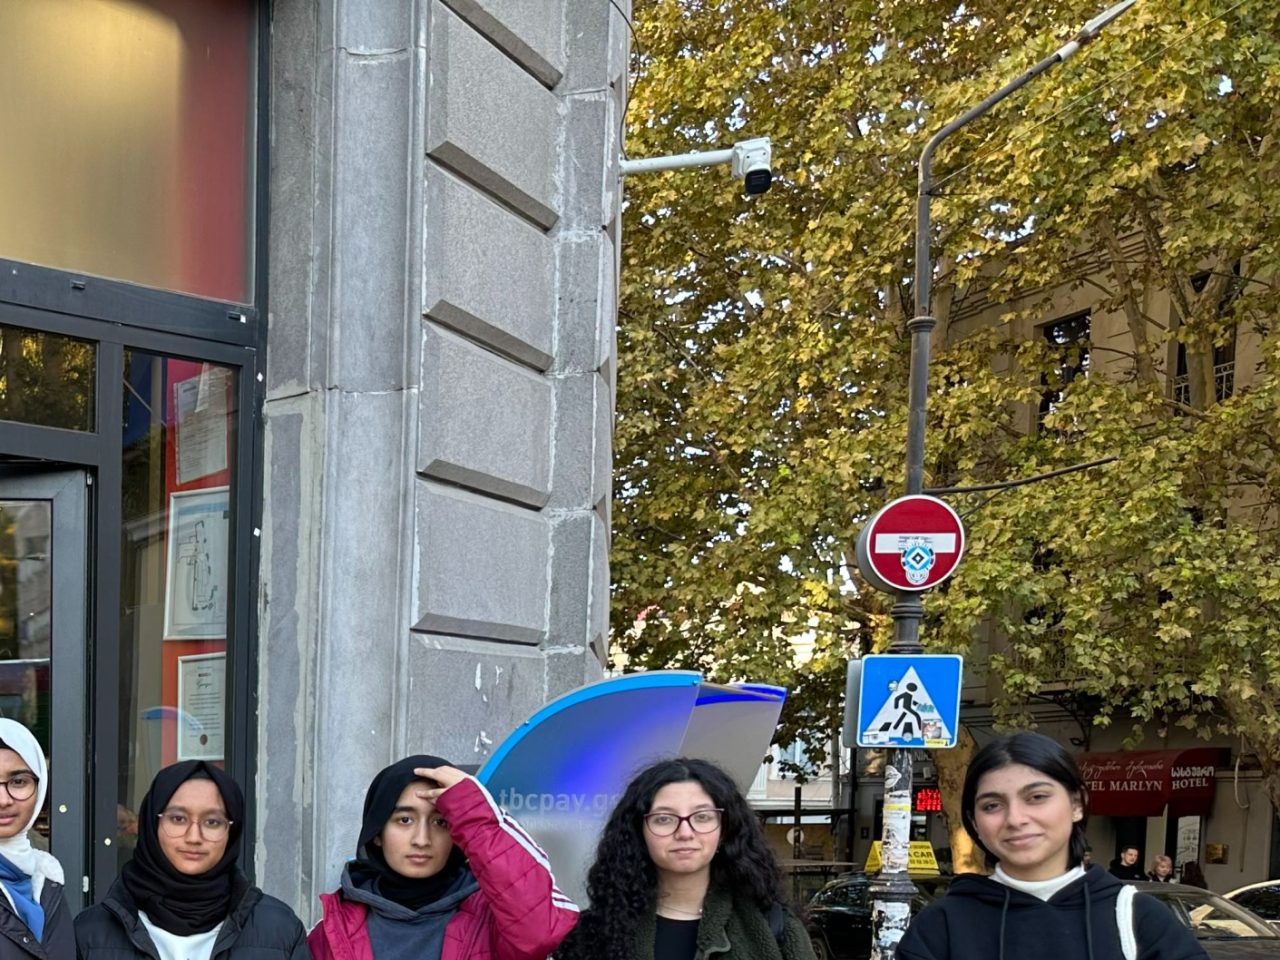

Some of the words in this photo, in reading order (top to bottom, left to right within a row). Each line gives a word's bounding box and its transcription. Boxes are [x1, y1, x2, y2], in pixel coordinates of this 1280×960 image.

[1110, 780, 1163, 792] MARLYN
[1172, 777, 1208, 790] HOTEL
[913, 850, 933, 859] CAR
